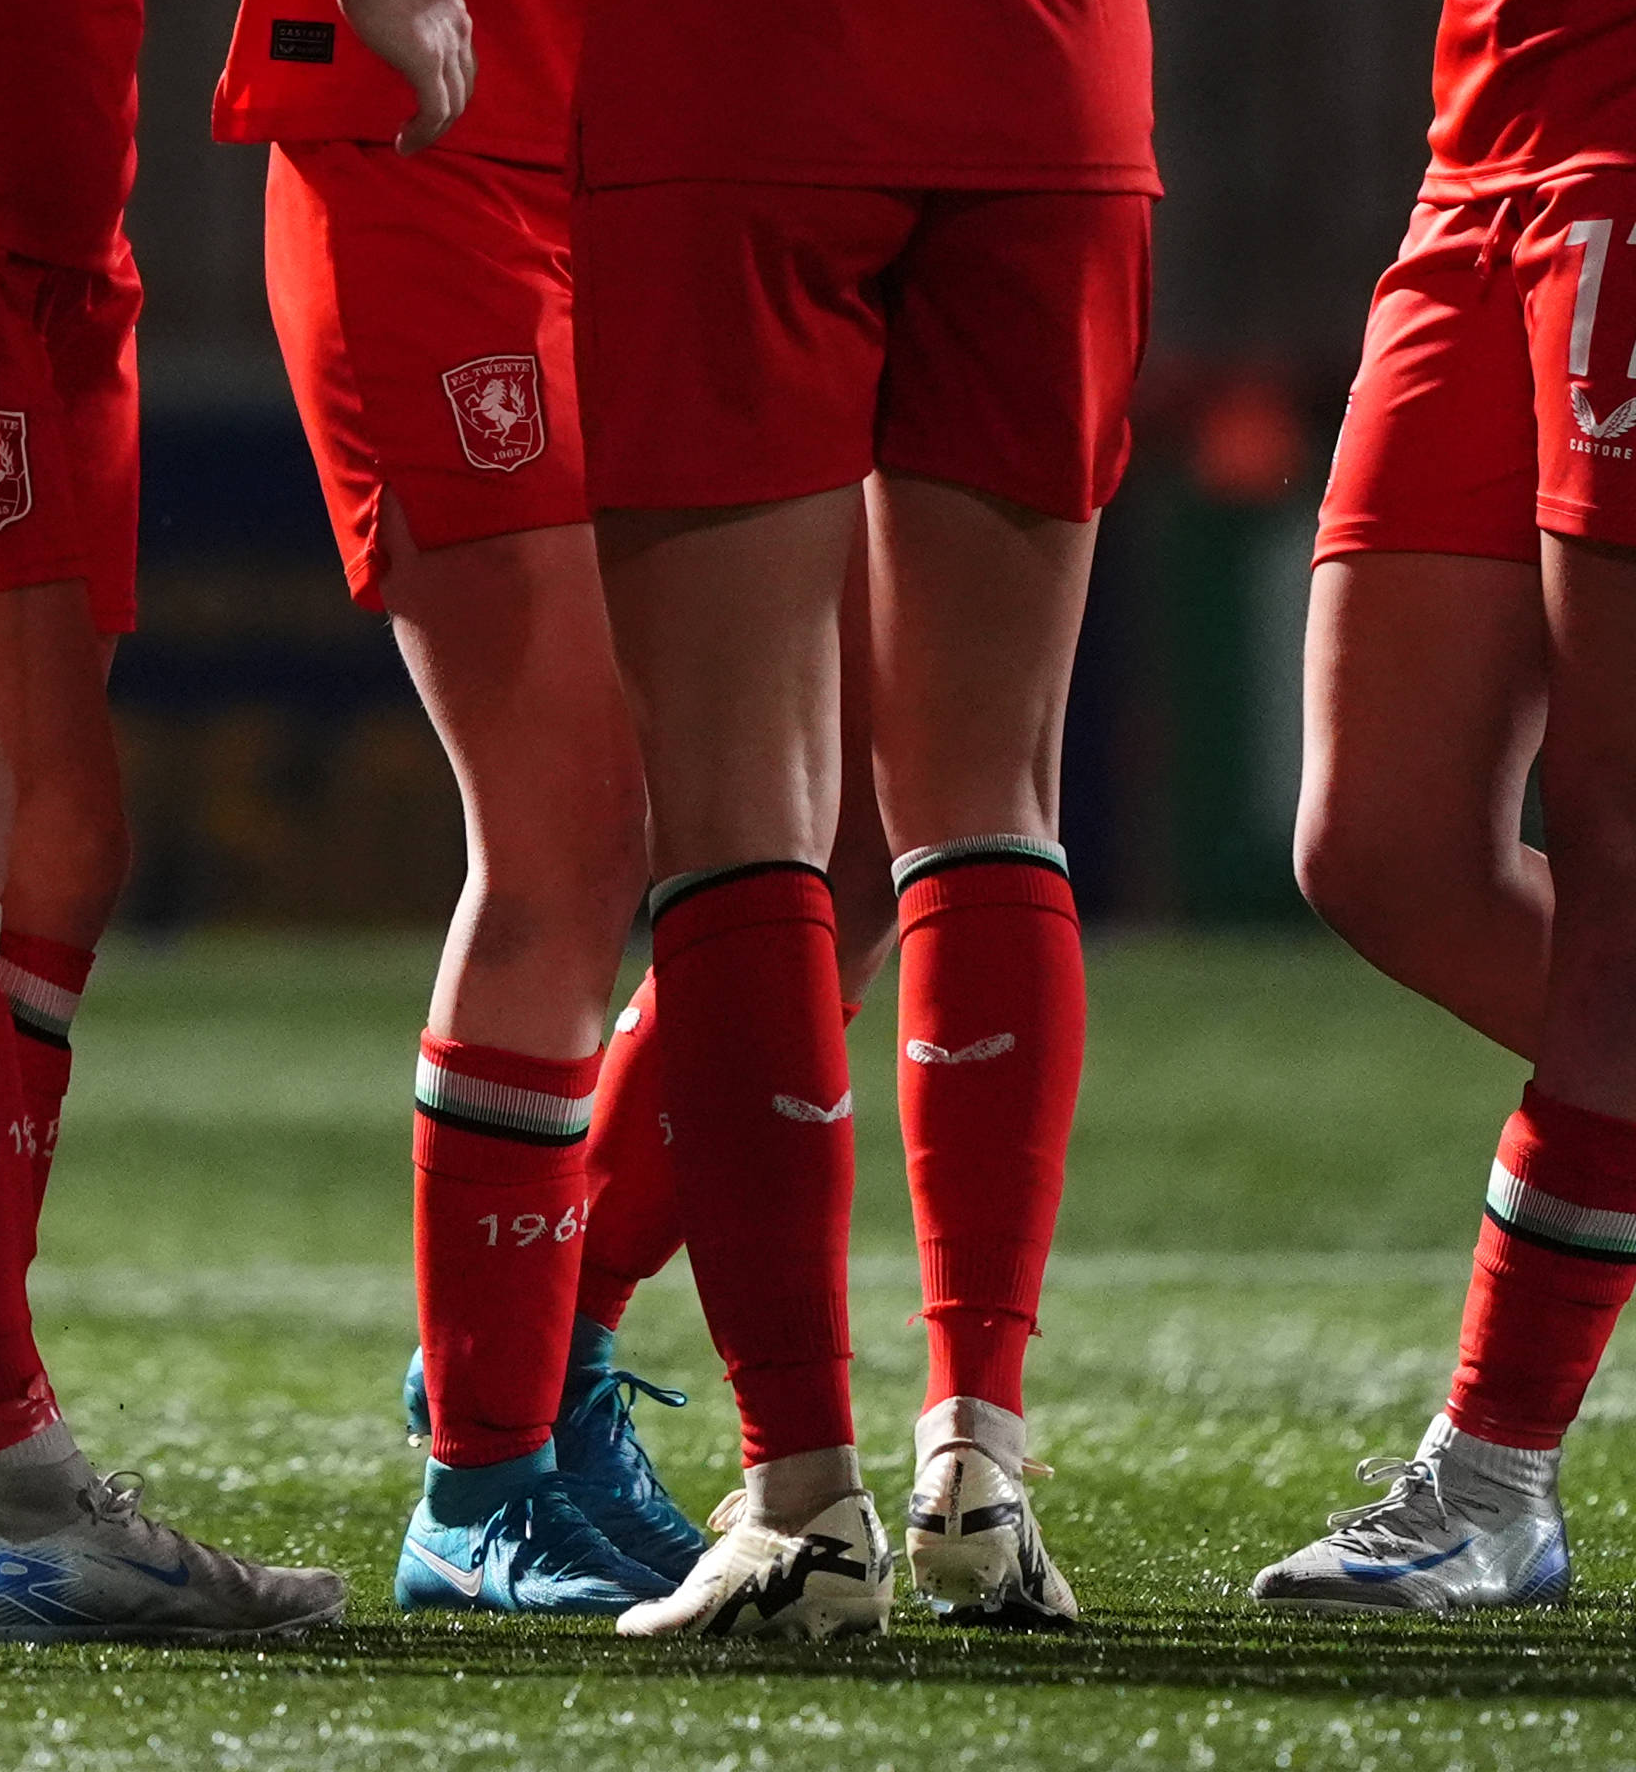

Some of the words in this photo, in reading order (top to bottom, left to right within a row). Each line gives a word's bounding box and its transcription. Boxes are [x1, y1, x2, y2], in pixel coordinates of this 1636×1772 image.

[472, 363, 531, 377] TWENTE
[493, 448, 522, 460] 1965
[1569, 438, 1632, 460] CASTORE
